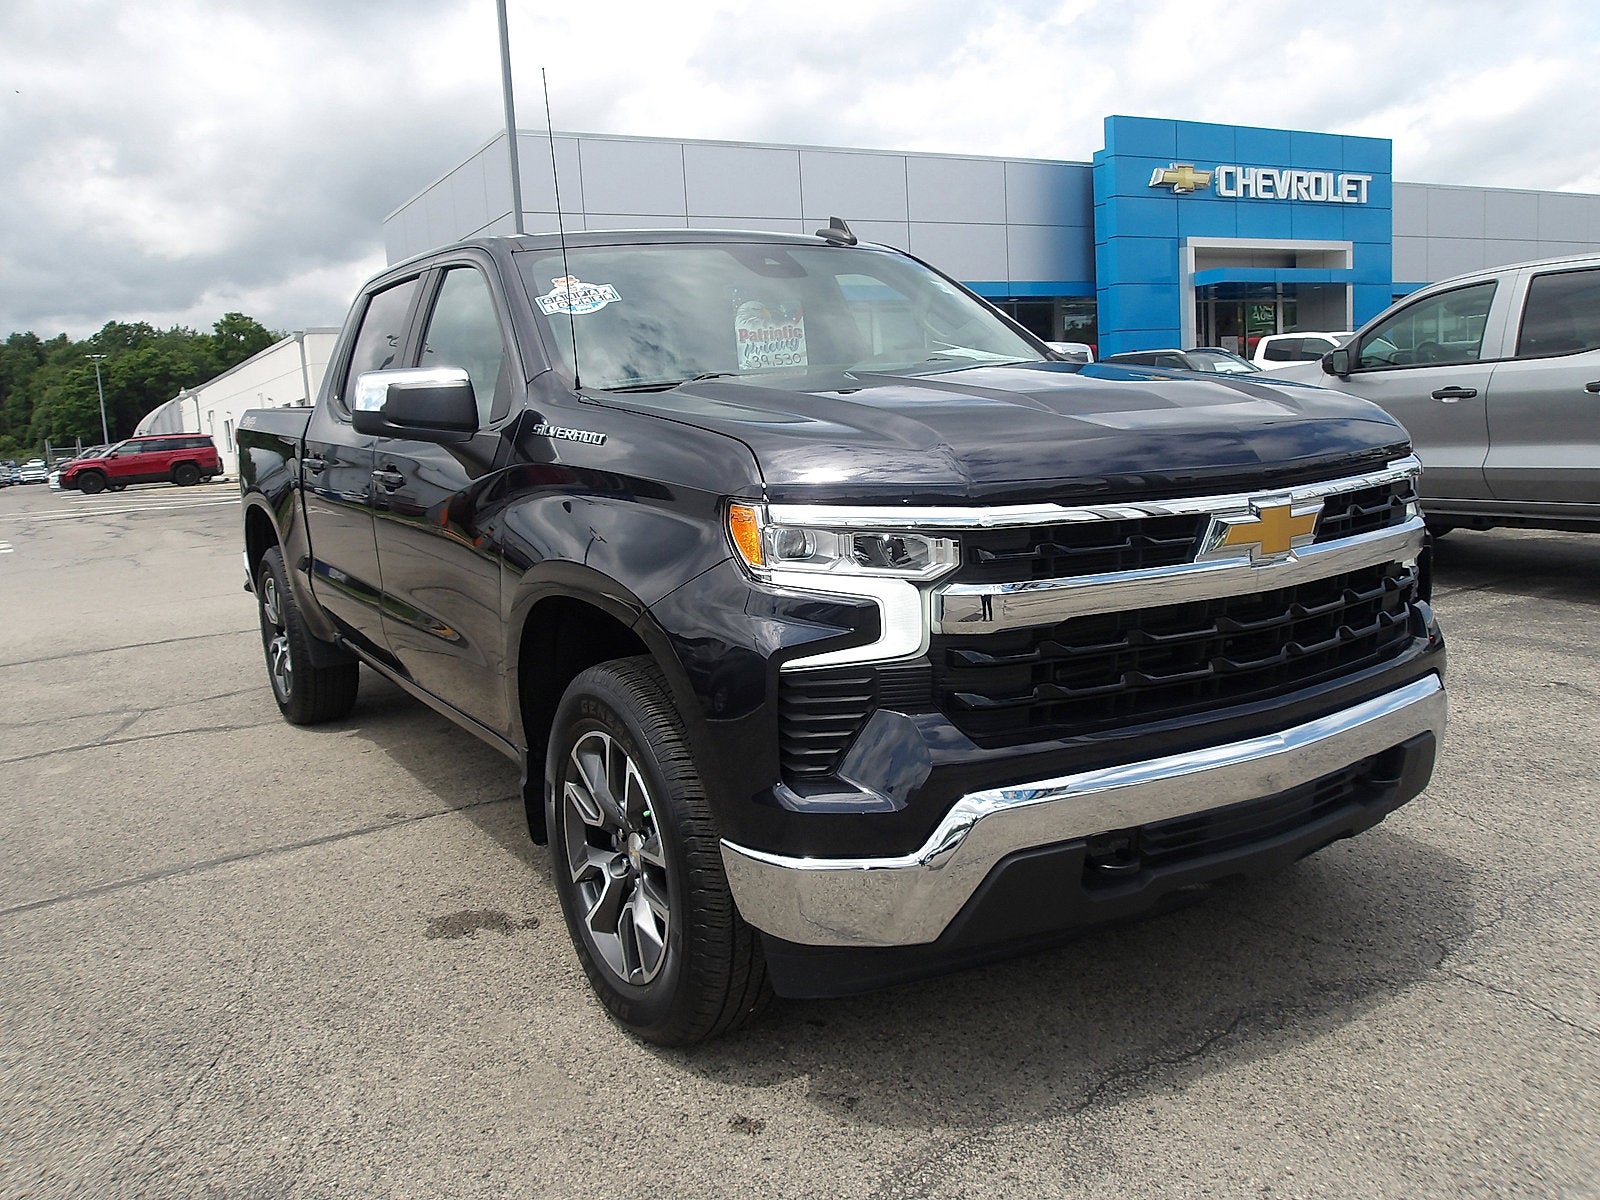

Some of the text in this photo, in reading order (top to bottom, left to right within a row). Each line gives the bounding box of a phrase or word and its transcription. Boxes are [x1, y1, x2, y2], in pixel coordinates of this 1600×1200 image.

[1214, 165, 1372, 203] CHEVROLET
[738, 325, 804, 342] Patriotic
[744, 338, 800, 359] Pricing
[745, 353, 802, 369] $39,530
[532, 424, 606, 444] SILVERADO
